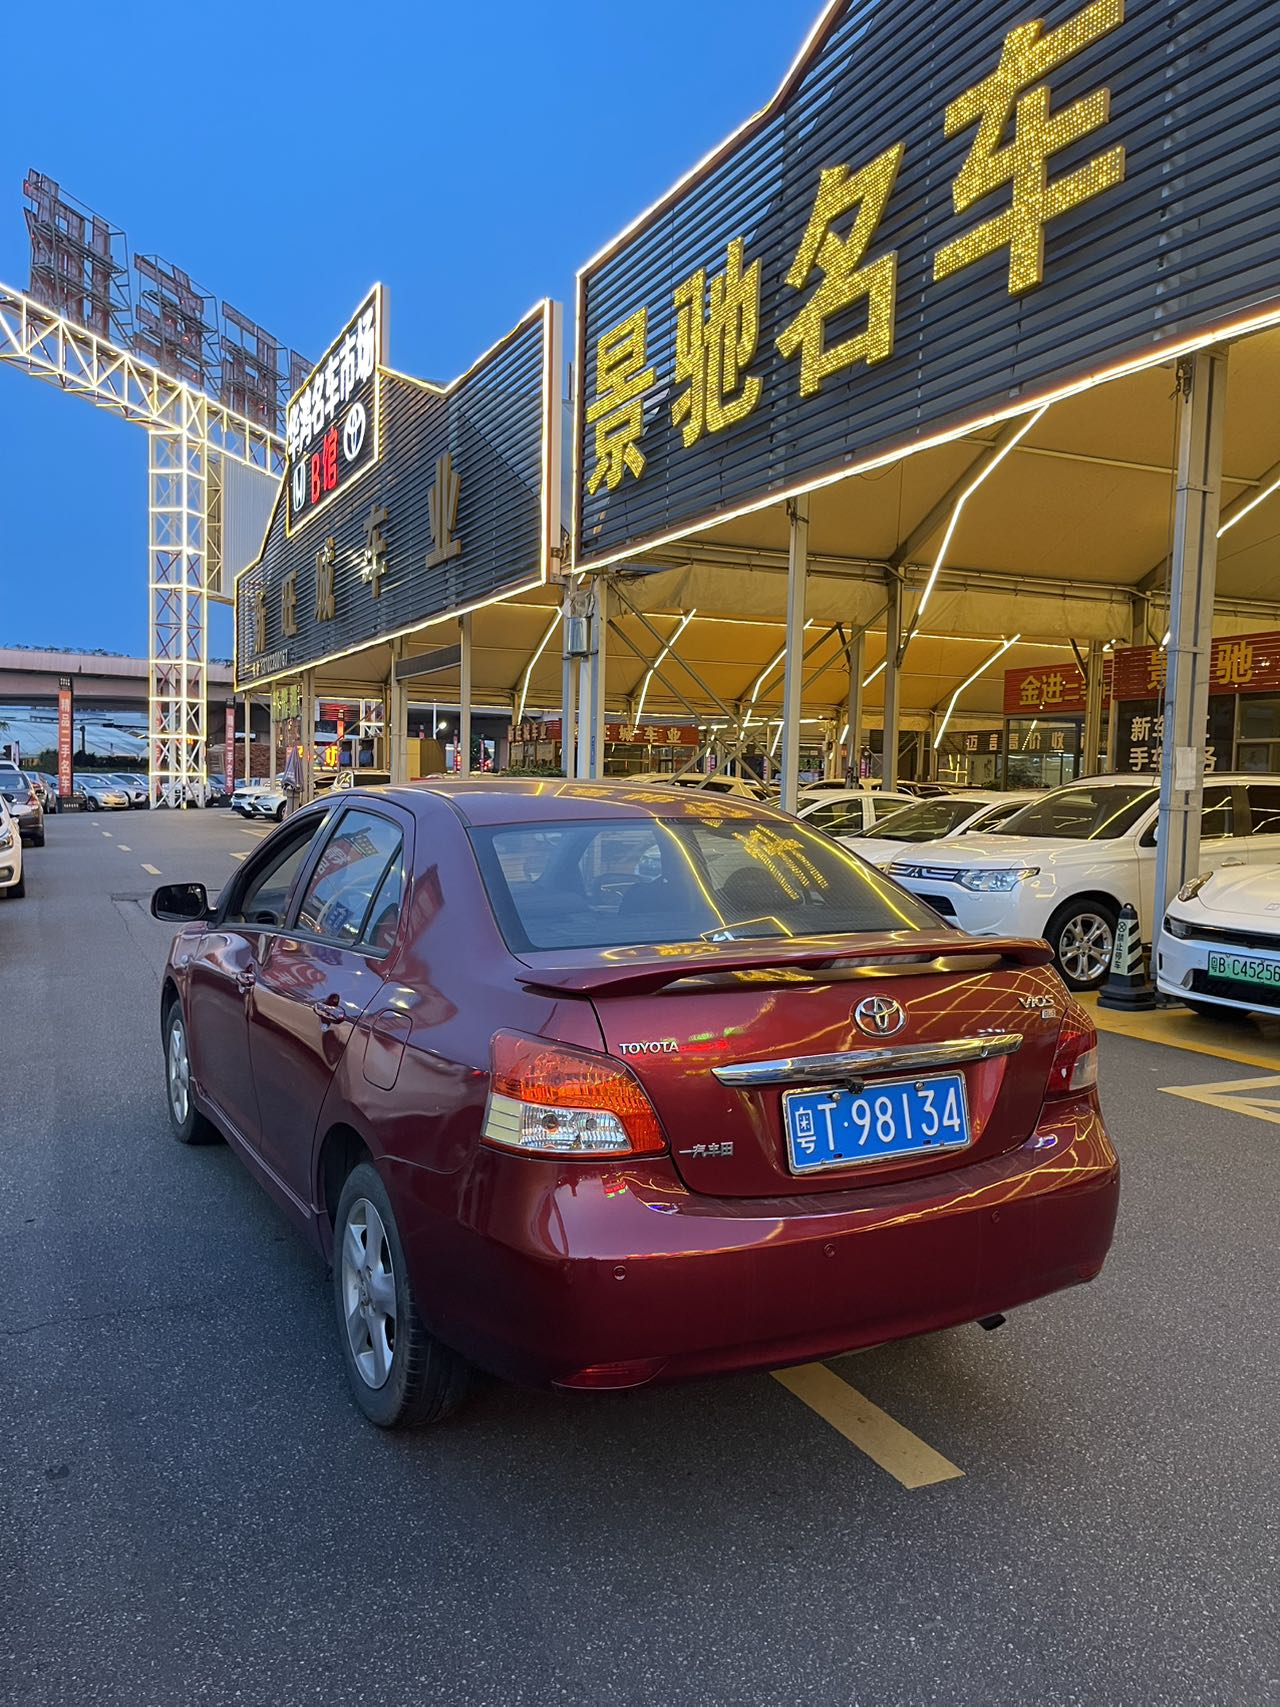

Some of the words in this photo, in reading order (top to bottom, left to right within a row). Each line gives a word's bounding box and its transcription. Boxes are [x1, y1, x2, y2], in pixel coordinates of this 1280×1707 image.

[586, 0, 1126, 495] 景驰名车
[1017, 994, 1055, 1009] VIOS
[619, 1041, 679, 1056] TOYOTA
[795, 1087, 961, 1155] 粤T·98134
[679, 1141, 734, 1159] 一汽丰田
